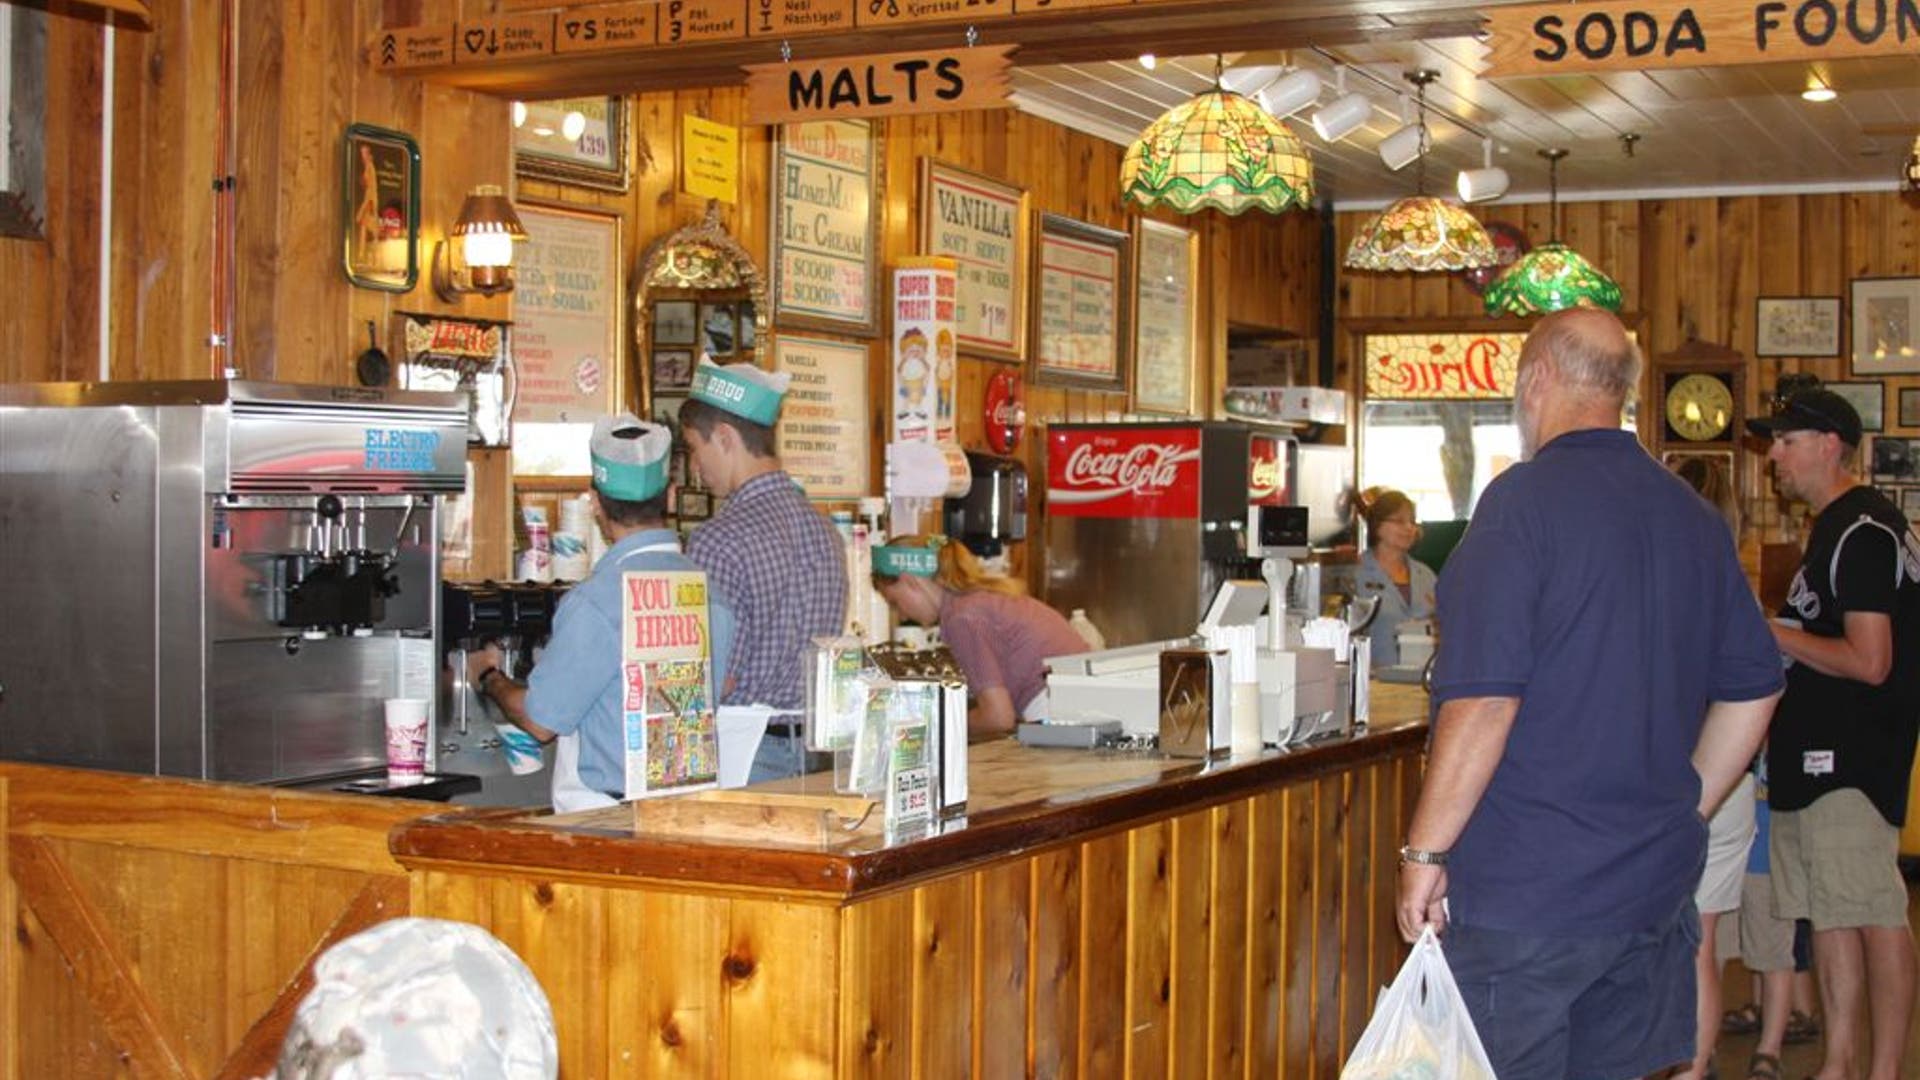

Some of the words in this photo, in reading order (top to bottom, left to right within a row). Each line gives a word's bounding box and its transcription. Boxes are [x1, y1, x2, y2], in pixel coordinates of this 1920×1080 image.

[1533, 8, 1706, 62] SODA
[789, 56, 965, 111] MALTS
[937, 188, 1012, 240] VANILLA
[814, 212, 863, 255] CREAM
[793, 257, 835, 282] SCOOP
[899, 275, 930, 297] SUPER
[791, 372, 827, 386] HOCOLATE
[364, 427, 441, 450] ELECTRO
[364, 450, 437, 472] FREEZE
[1065, 442, 1182, 488] Coca-Cola
[627, 577, 671, 612] YOU
[635, 613, 701, 649] HERE
